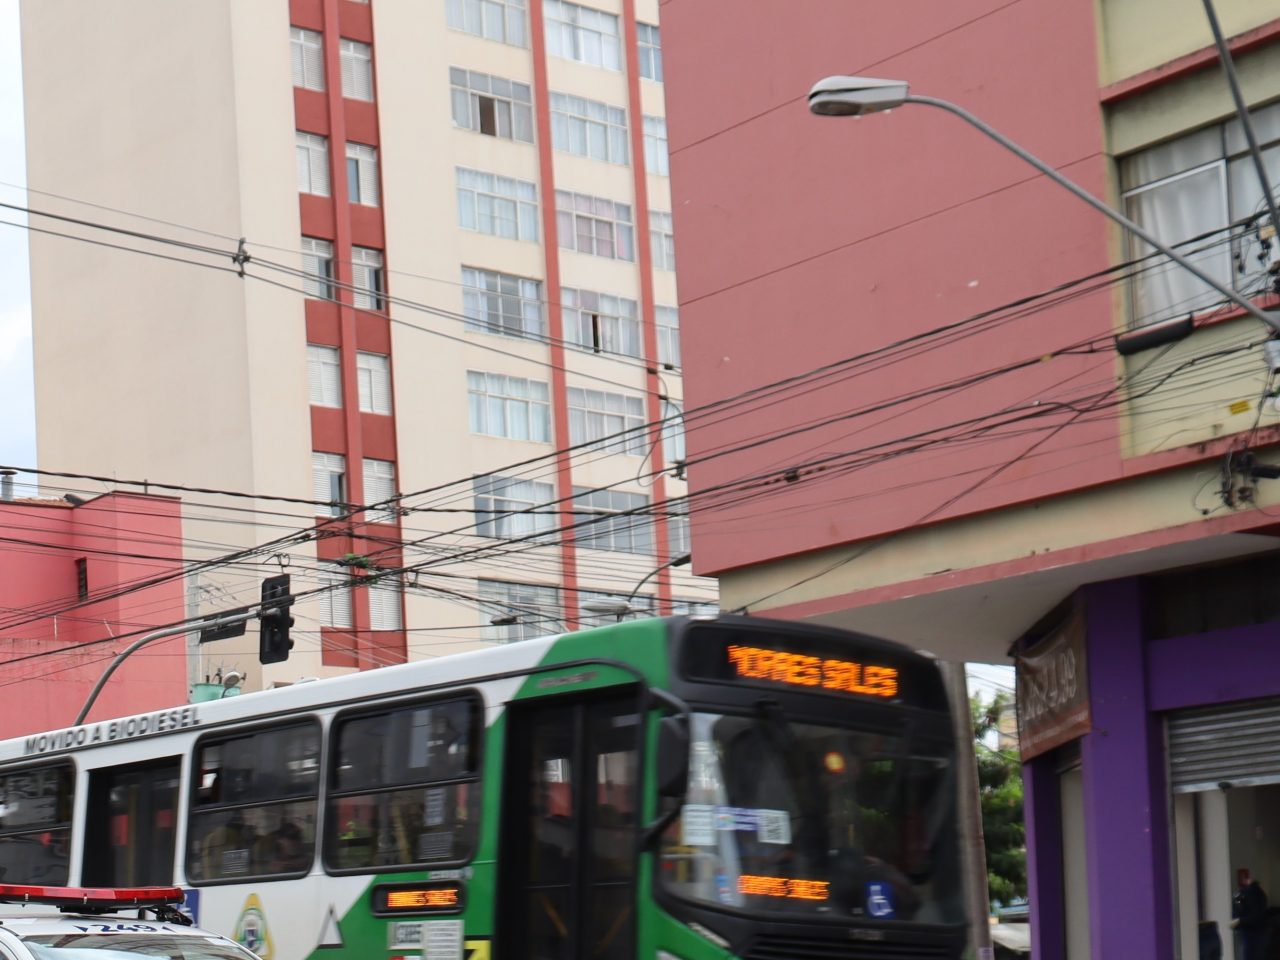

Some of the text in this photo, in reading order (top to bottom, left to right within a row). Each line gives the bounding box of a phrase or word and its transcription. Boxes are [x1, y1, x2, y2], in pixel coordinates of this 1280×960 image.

[25, 707, 201, 755] MOVIDO A BIODIESEL
